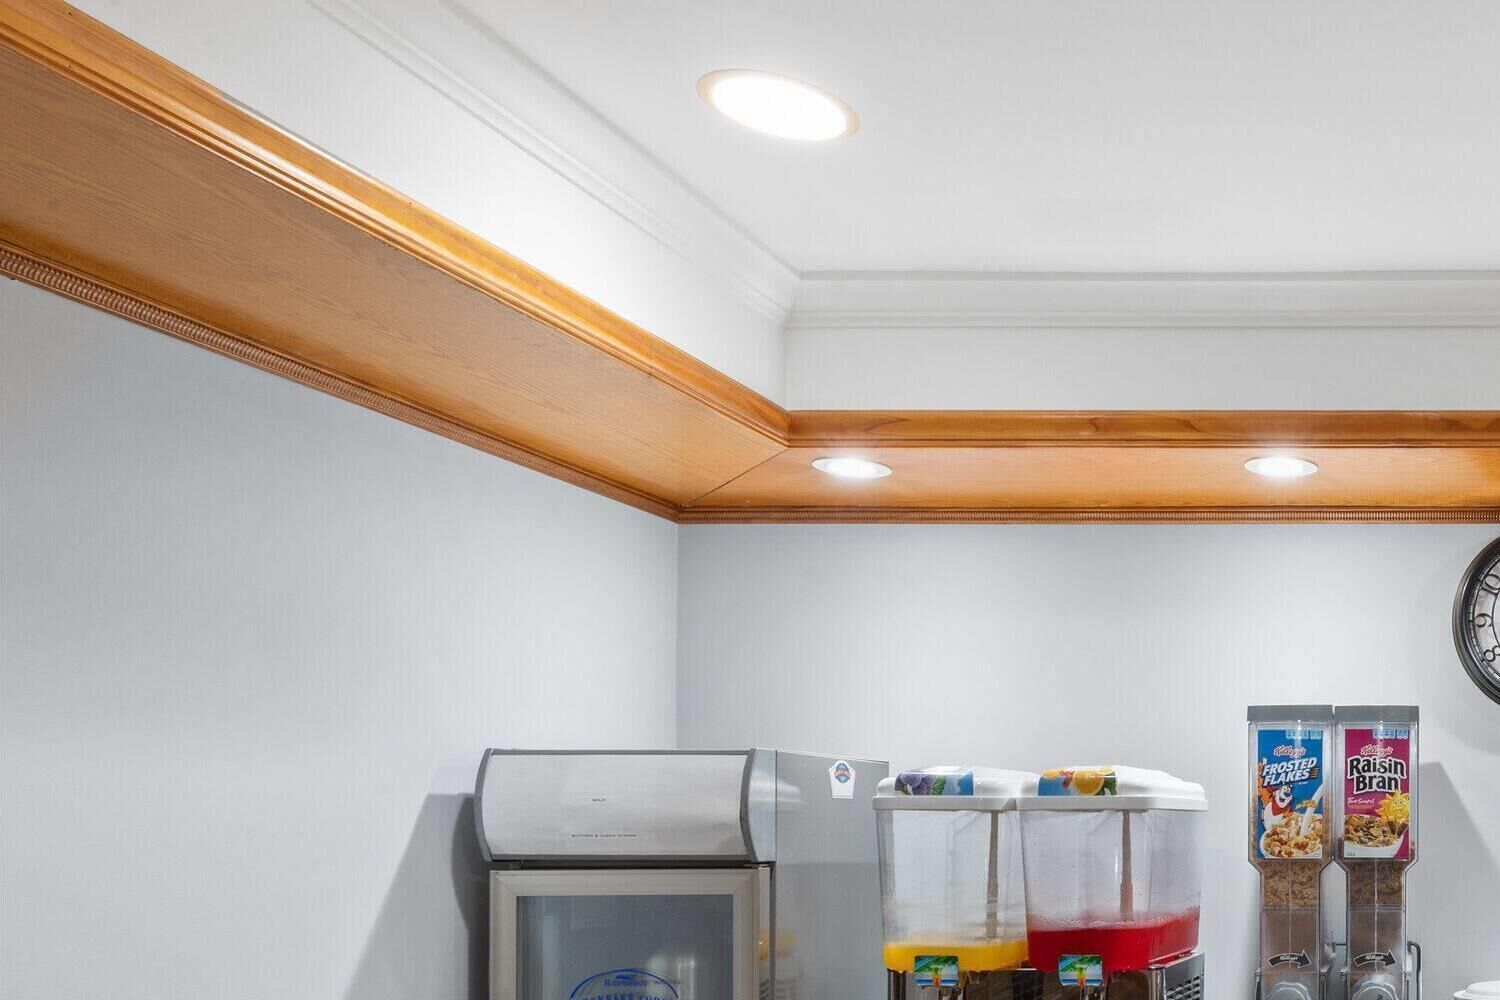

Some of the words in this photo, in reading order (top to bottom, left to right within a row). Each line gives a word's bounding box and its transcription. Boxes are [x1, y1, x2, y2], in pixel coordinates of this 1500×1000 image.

[1263, 757, 1317, 777] FROSTED
[1263, 768, 1310, 786] FLAKES
[1347, 756, 1406, 779] Raisin
[1353, 773, 1400, 794] Bran
